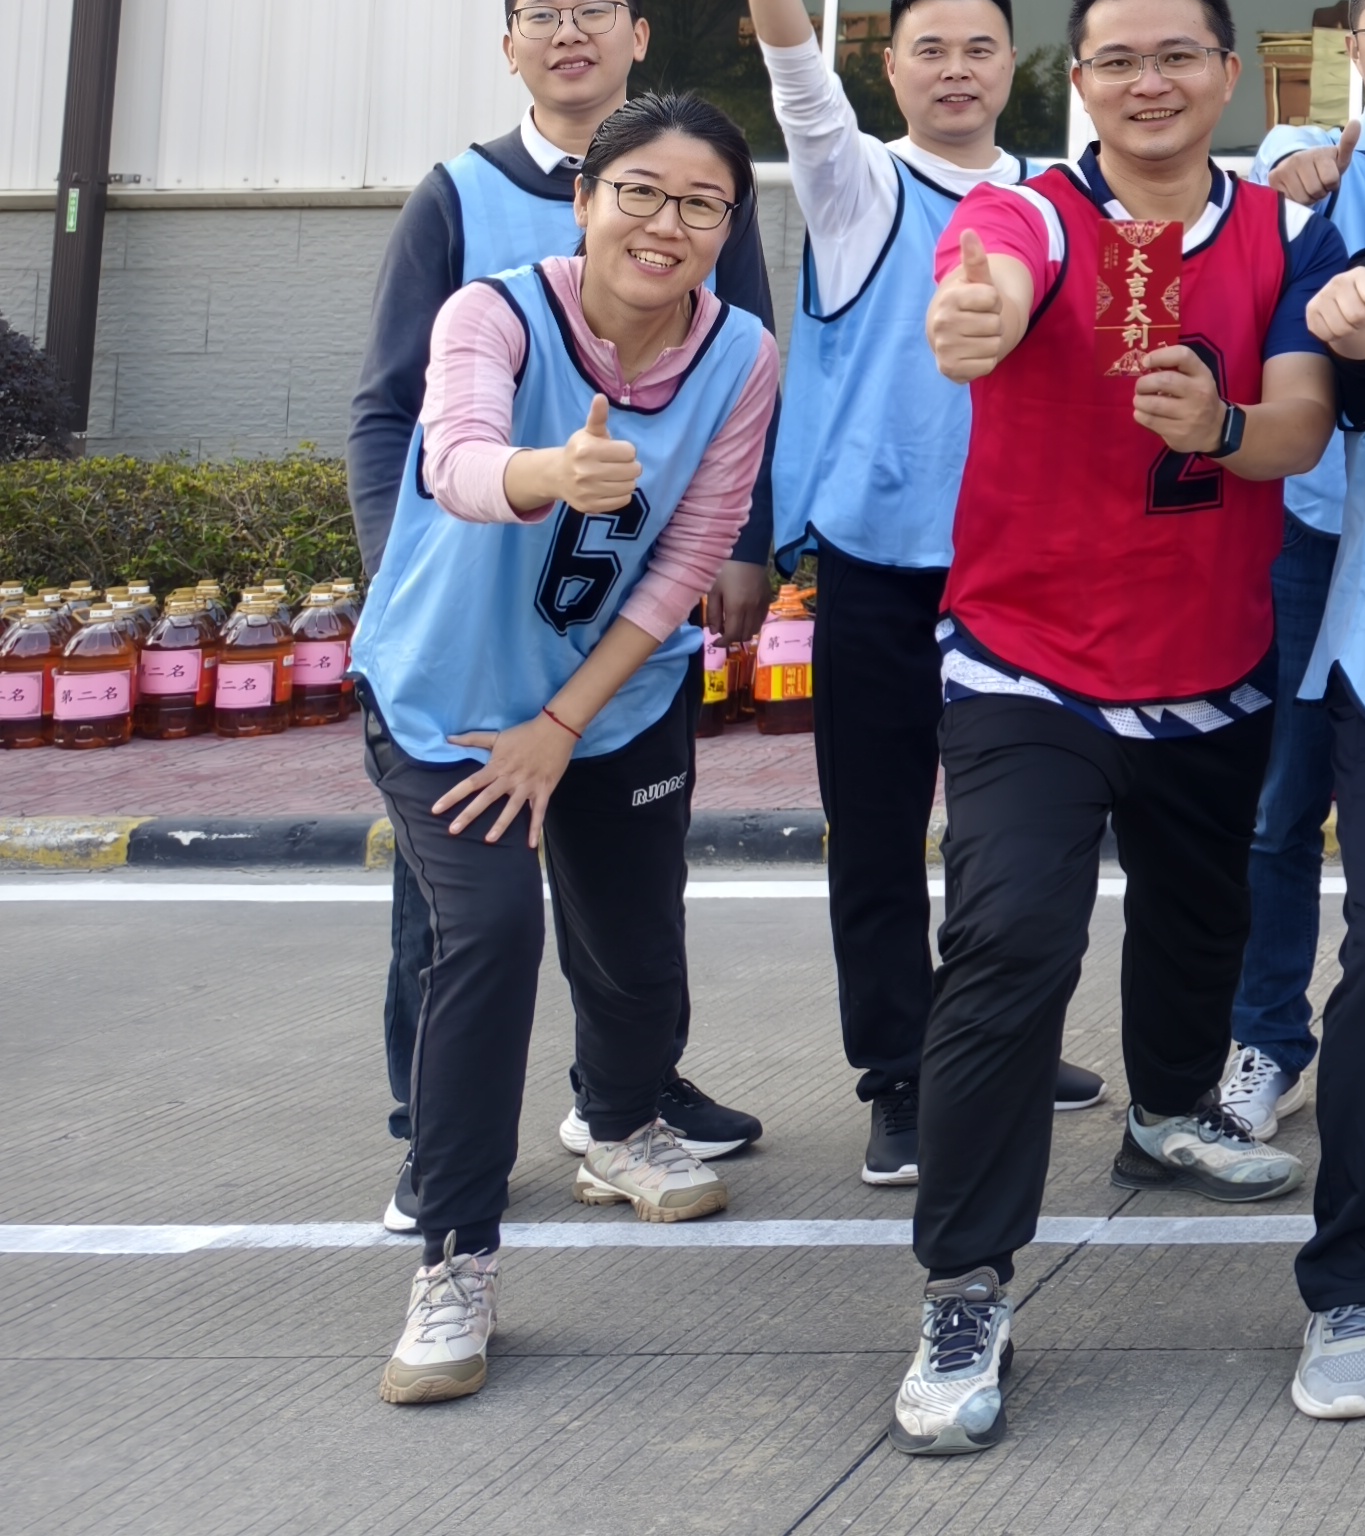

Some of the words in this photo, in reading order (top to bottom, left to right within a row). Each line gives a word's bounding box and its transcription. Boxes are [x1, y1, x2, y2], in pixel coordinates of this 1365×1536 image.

[1122, 249, 1153, 349] 大吉大利
[534, 487, 651, 636] 6
[61, 686, 118, 704] 第二名
